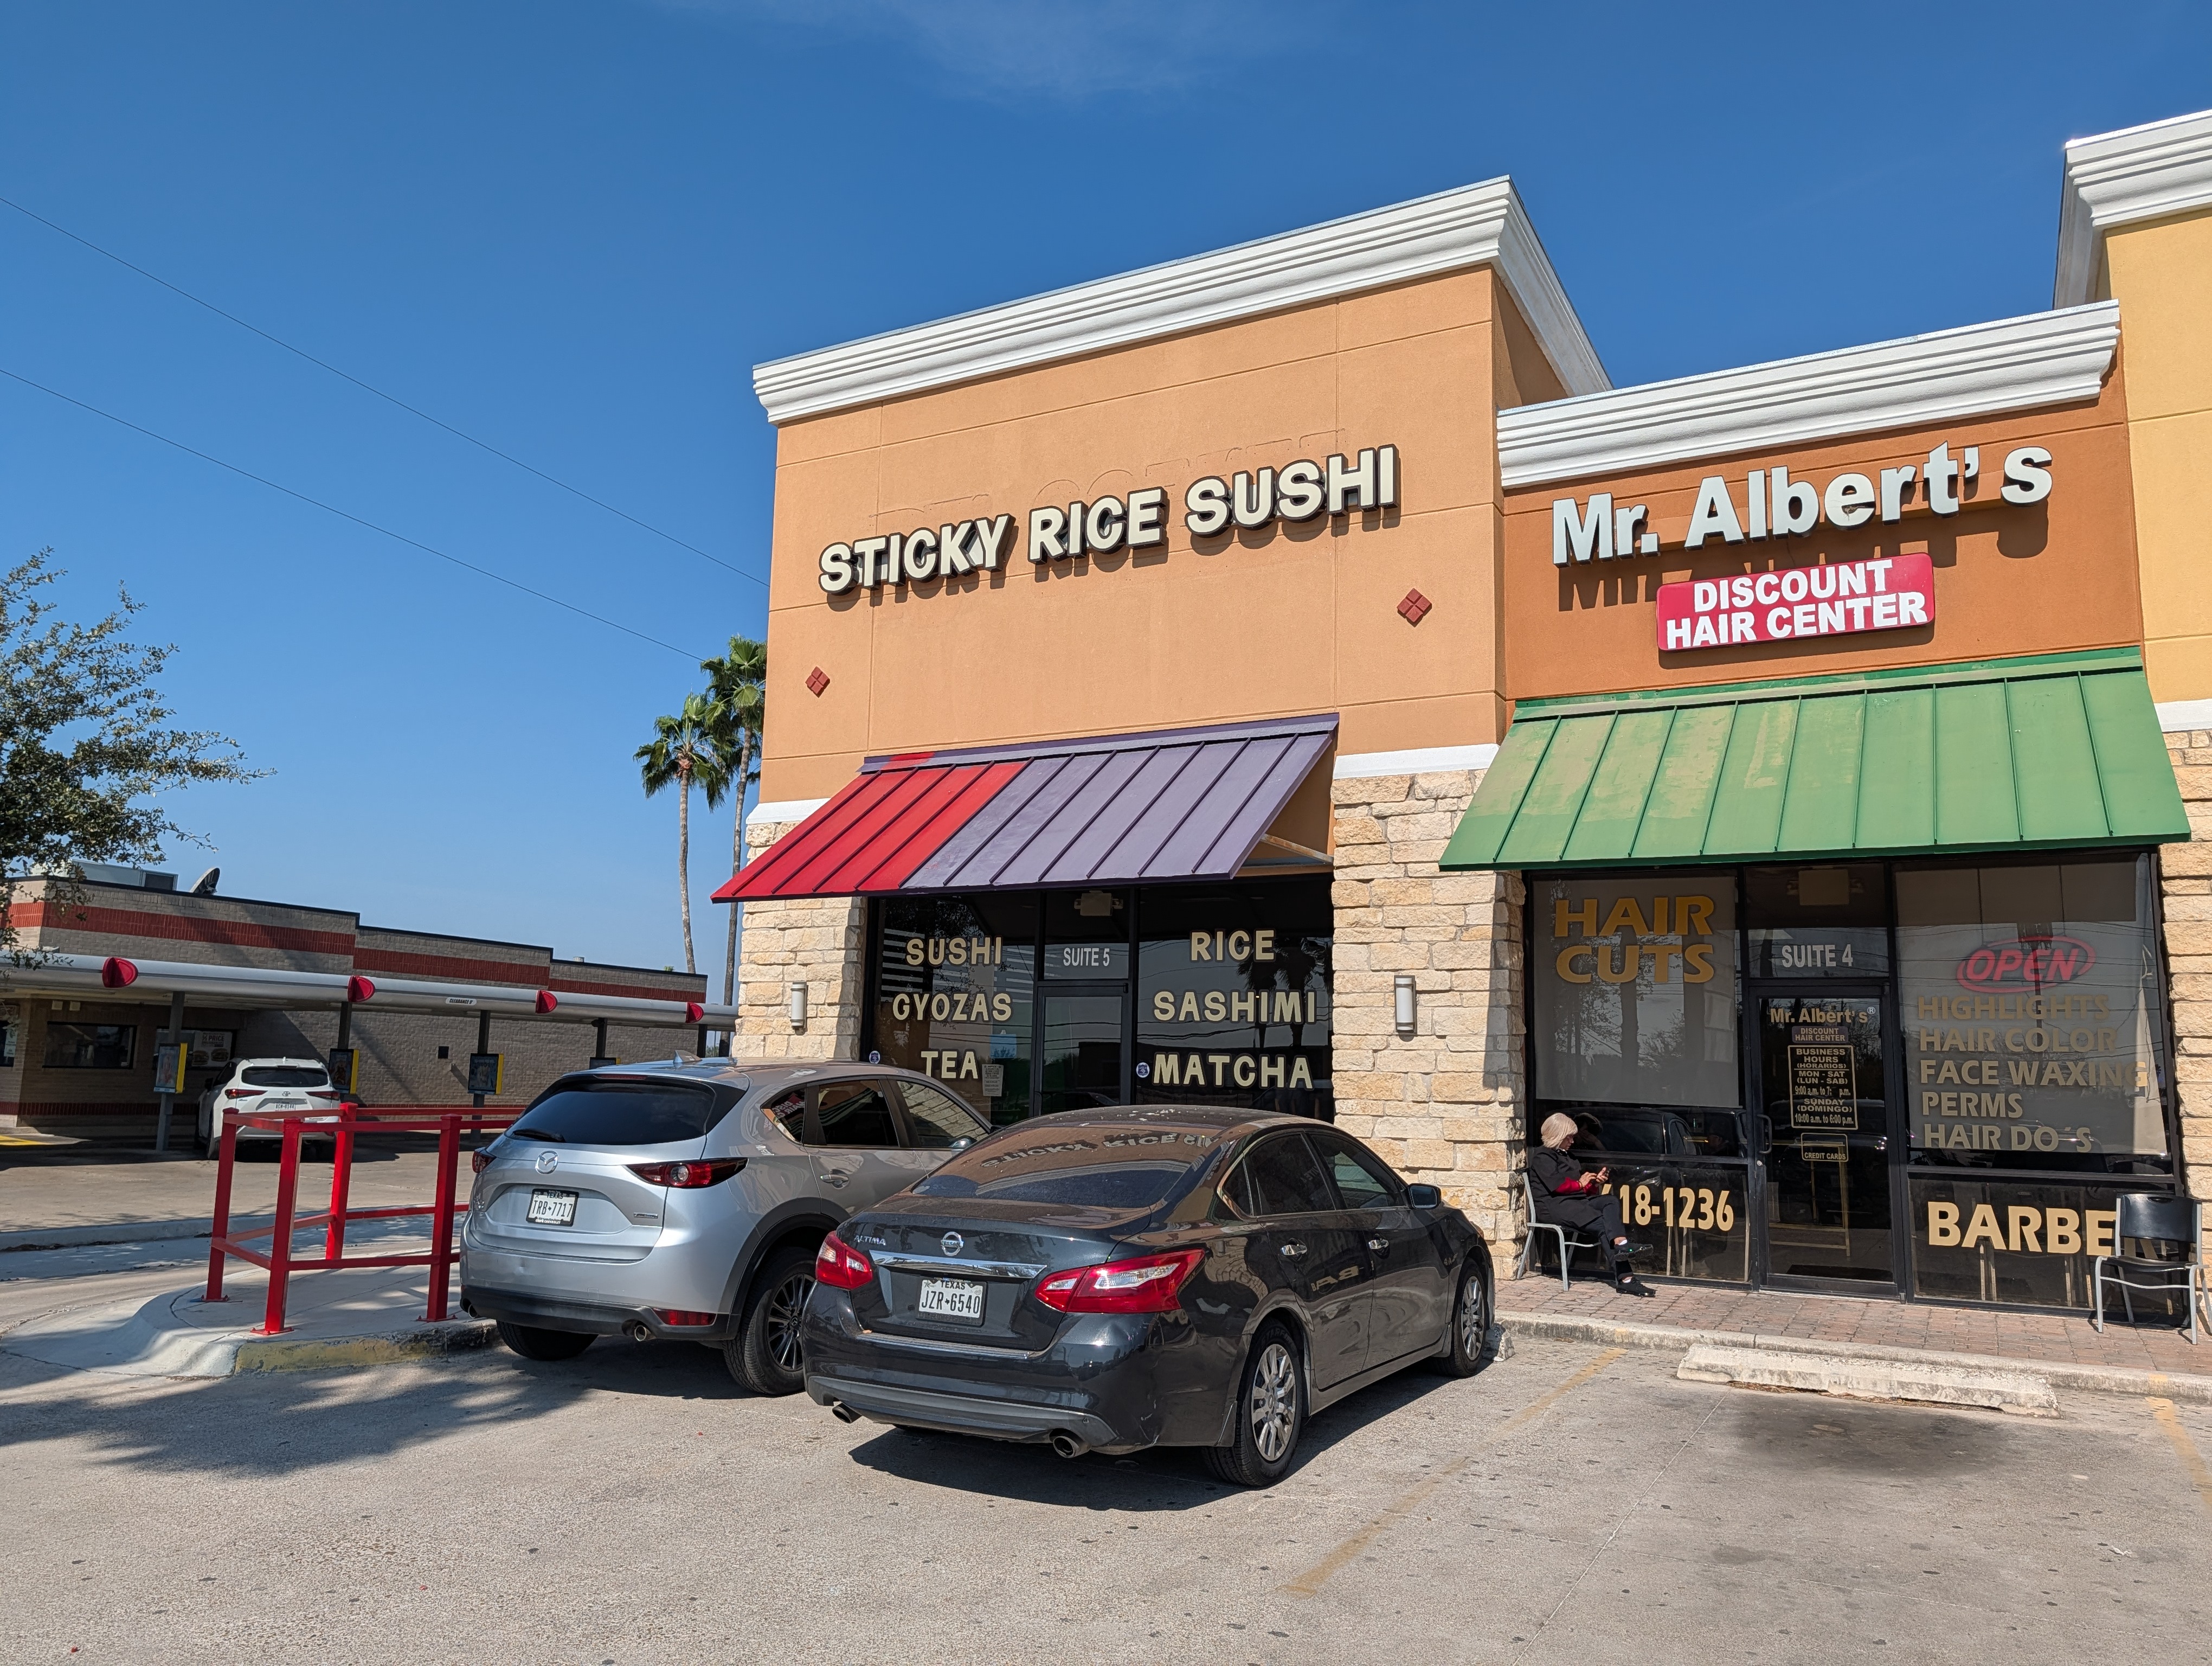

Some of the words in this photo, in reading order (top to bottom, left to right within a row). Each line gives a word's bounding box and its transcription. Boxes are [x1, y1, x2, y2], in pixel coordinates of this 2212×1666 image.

[819, 513, 1015, 595] STICKY
[1028, 486, 1167, 563] RICE
[1185, 444, 1400, 536] SUSHI
[1552, 492, 1659, 567] Mr.
[1694, 559, 1893, 613] DISCOUNT
[1666, 611, 1756, 650] HAIR
[1766, 591, 1928, 640] CENTER
[1554, 895, 1714, 937] HAIR
[906, 937, 1002, 966] SUSHI
[1063, 947, 1099, 966] SUITE
[1103, 948, 1110, 966] 5
[1191, 930, 1276, 961] RICE
[1782, 944, 1836, 967] SUITE
[1842, 944, 1853, 966] 4
[1555, 944, 1714, 983] CUTS
[1965, 947, 2079, 982] OPEN
[892, 992, 1012, 1022] GYOZAS
[1154, 990, 1316, 1023] SASHIMI
[1770, 1008, 1795, 1023] Mr.
[1918, 995, 2110, 1020] HIGHLIGHTS
[1920, 1027, 1996, 1052] HAIR
[2005, 1027, 2117, 1053] COLOR
[921, 1050, 979, 1079] TEA
[1153, 1053, 1313, 1088] MATCHA
[1920, 1060, 1999, 1085] FACE
[2008, 1060, 2147, 1087] WAXING
[1795, 1085, 1806, 1094] 9:00
[1819, 1086, 1825, 1095] to
[1922, 1091, 2023, 1118] PERMS
[1795, 1113, 1809, 1123] 10:00
[1823, 1114, 1828, 1123] to
[1829, 1114, 1841, 1124] 6:00
[1924, 1123, 2003, 1150] HAIR
[1602, 1184, 1734, 1232] 18-1236
[854, 1235, 886, 1246] ALTIMA
[941, 1280, 965, 1290] TEXAS
